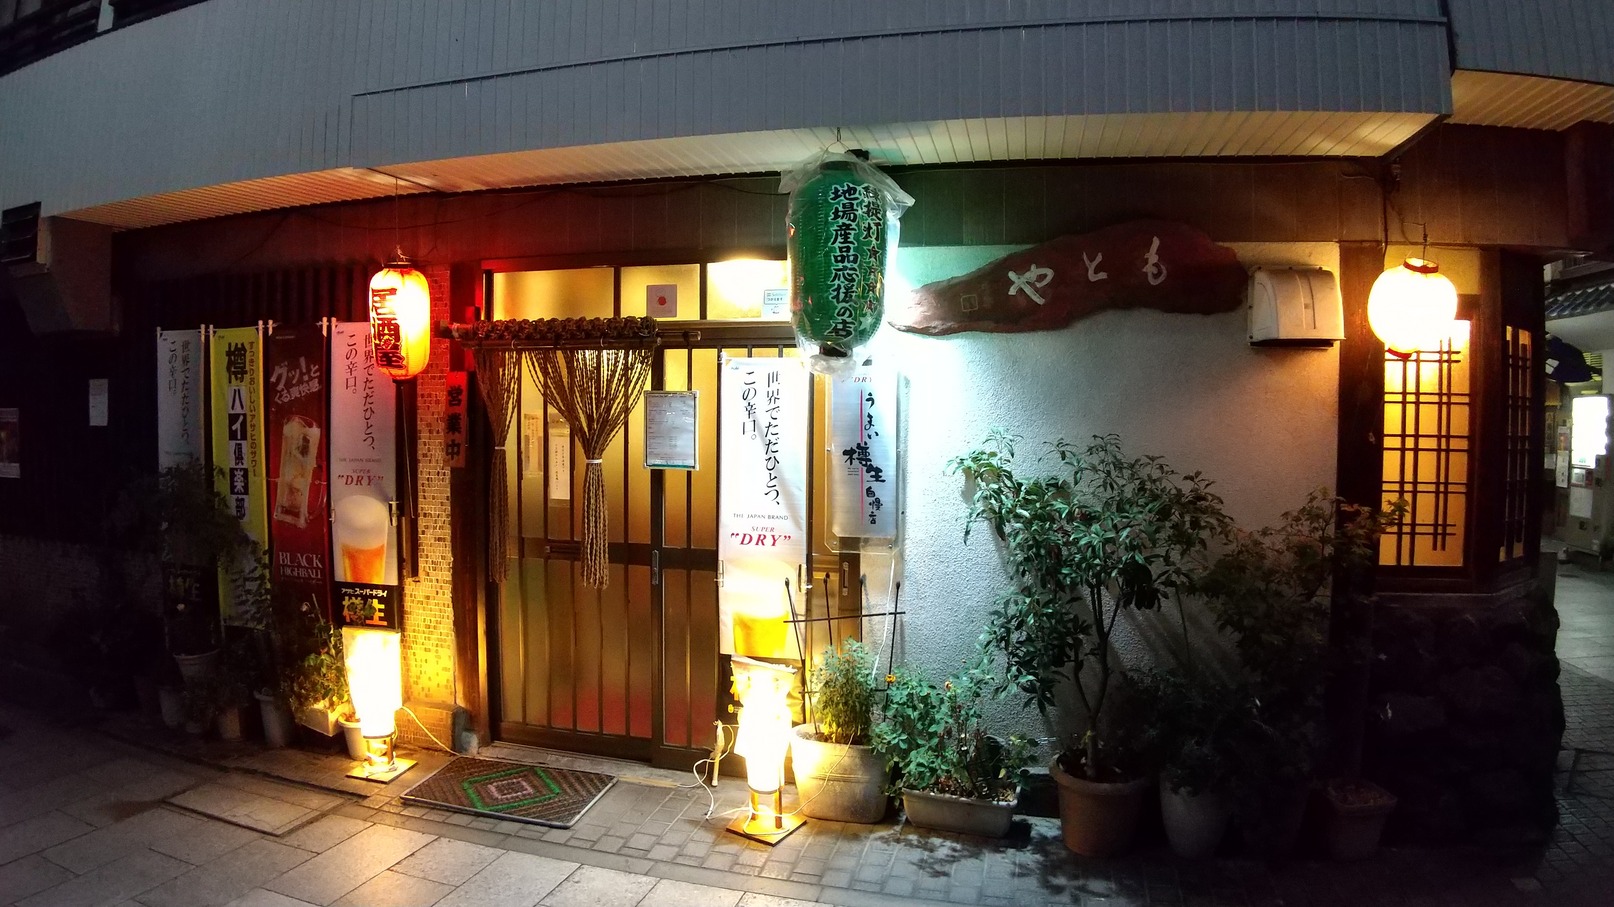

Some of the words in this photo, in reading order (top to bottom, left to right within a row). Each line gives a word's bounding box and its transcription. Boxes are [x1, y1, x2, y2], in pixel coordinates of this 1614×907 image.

[827, 183, 860, 339] 地場産品応援の店
[225, 341, 249, 521] 樽ハイ倶楽部
[446, 384, 464, 461] 営業中
[278, 551, 323, 568] BLACK
[280, 565, 323, 579] HIGHBALL
